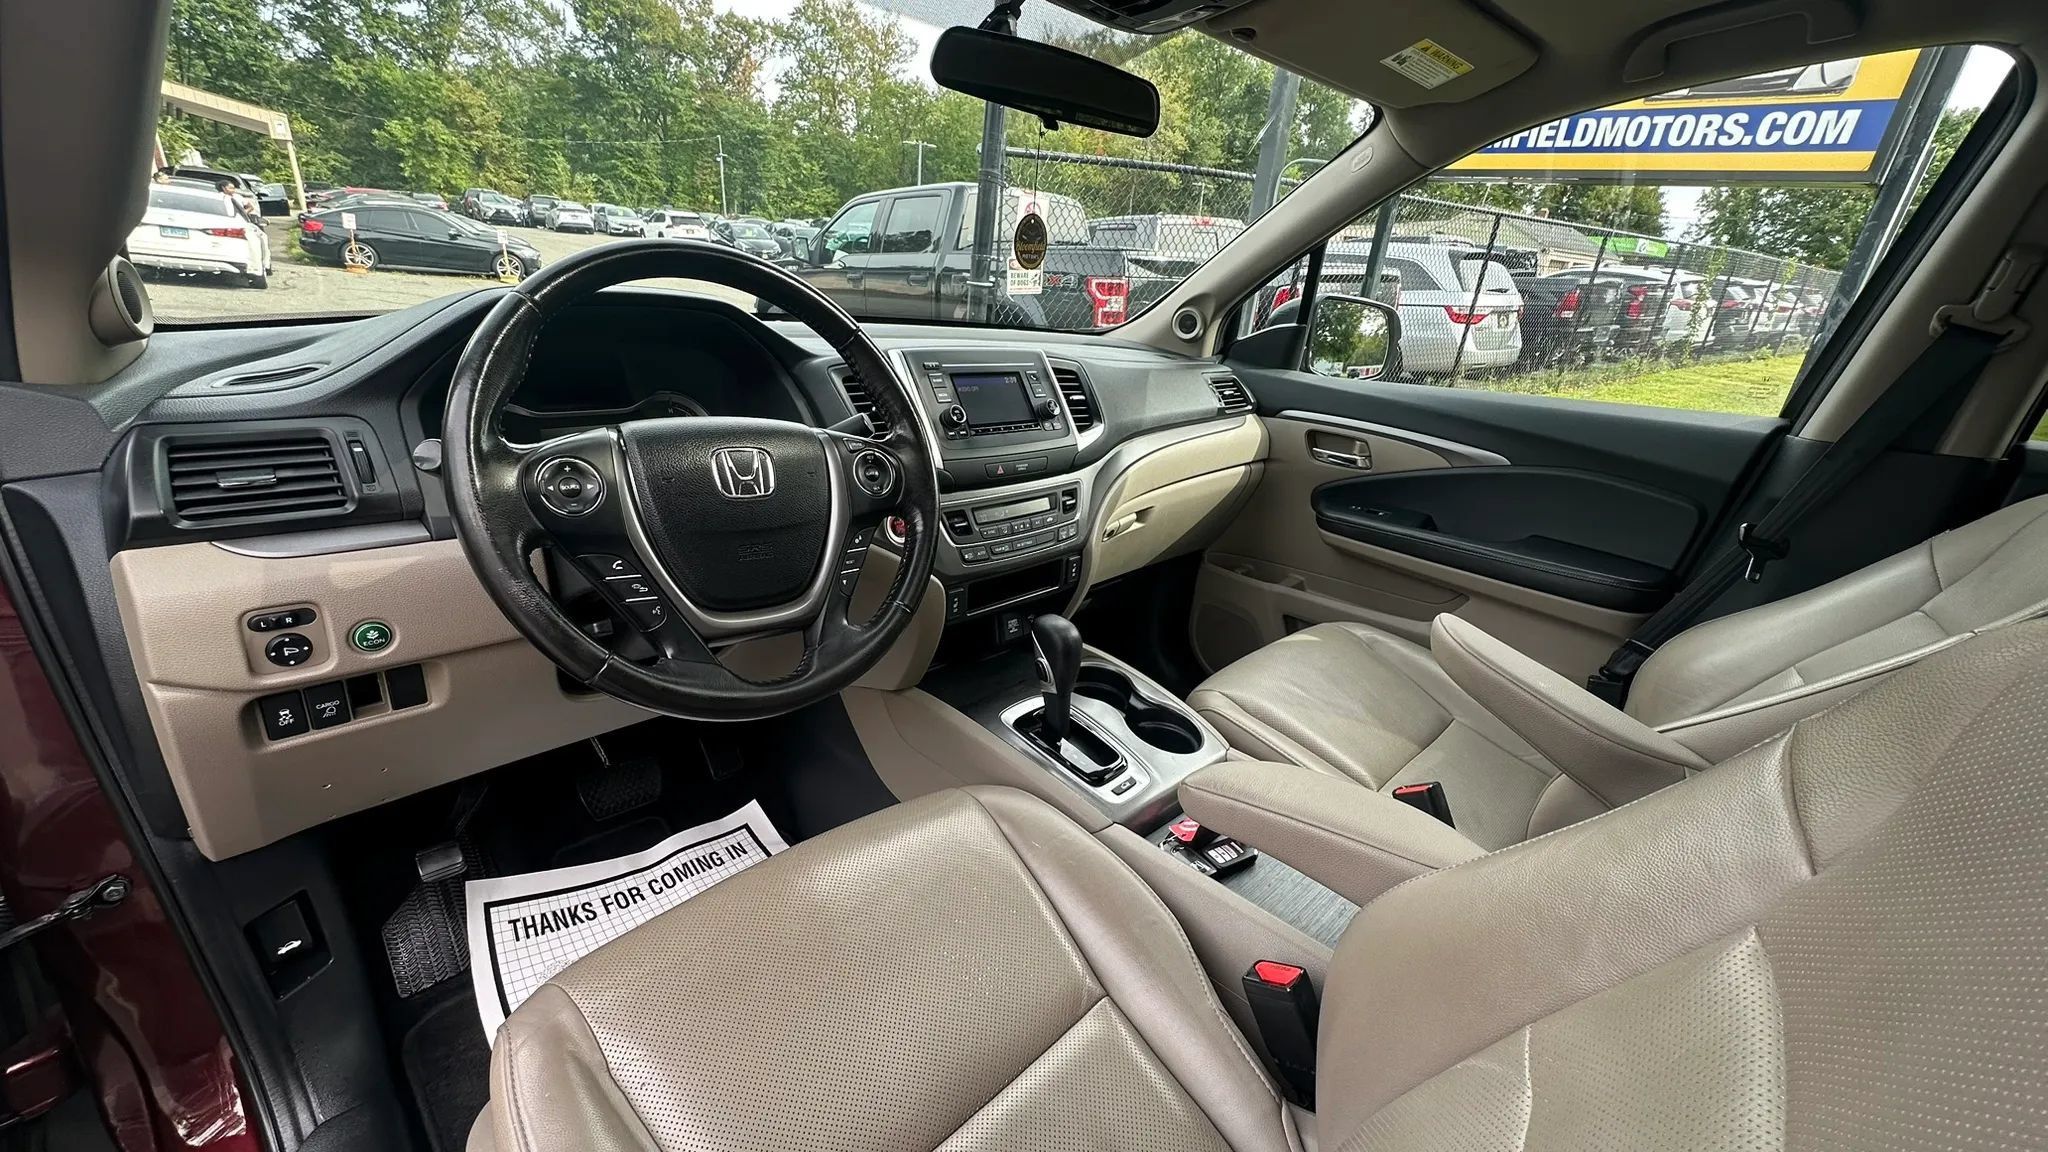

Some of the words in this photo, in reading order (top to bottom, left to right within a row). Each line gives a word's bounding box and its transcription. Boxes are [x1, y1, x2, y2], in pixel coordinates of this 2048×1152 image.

[1431, 48, 1464, 70] WARNING
[363, 638, 386, 647] ECON
[316, 700, 340, 710] CARGO
[279, 717, 295, 727] OFF
[508, 901, 598, 942] THANKS
[600, 886, 646, 915] FOR
[648, 850, 726, 896] COMING
[724, 841, 749, 861] IN
